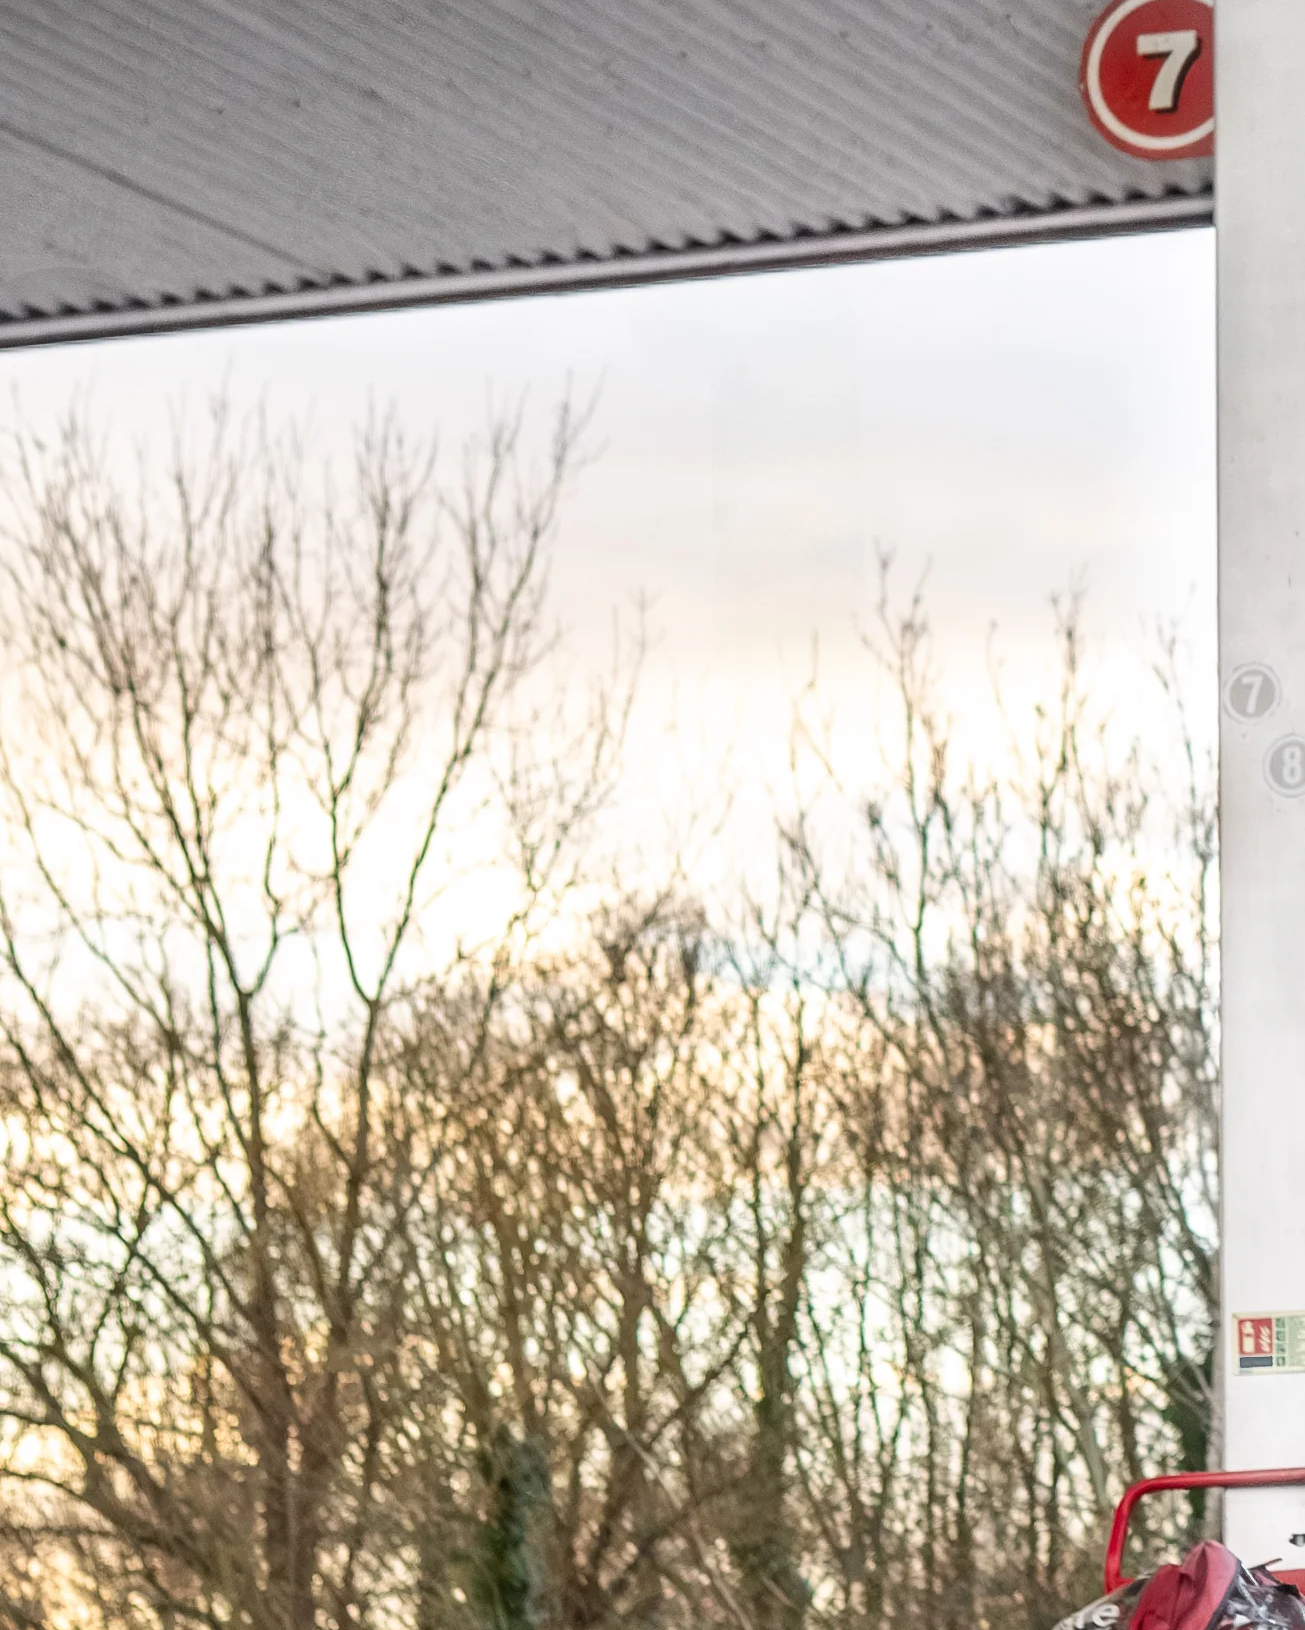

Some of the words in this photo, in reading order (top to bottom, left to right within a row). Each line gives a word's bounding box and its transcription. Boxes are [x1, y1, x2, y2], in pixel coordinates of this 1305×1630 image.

[1136, 29, 1200, 113] 7
[1240, 673, 1264, 714] 7
[1282, 745, 1303, 786] 8
